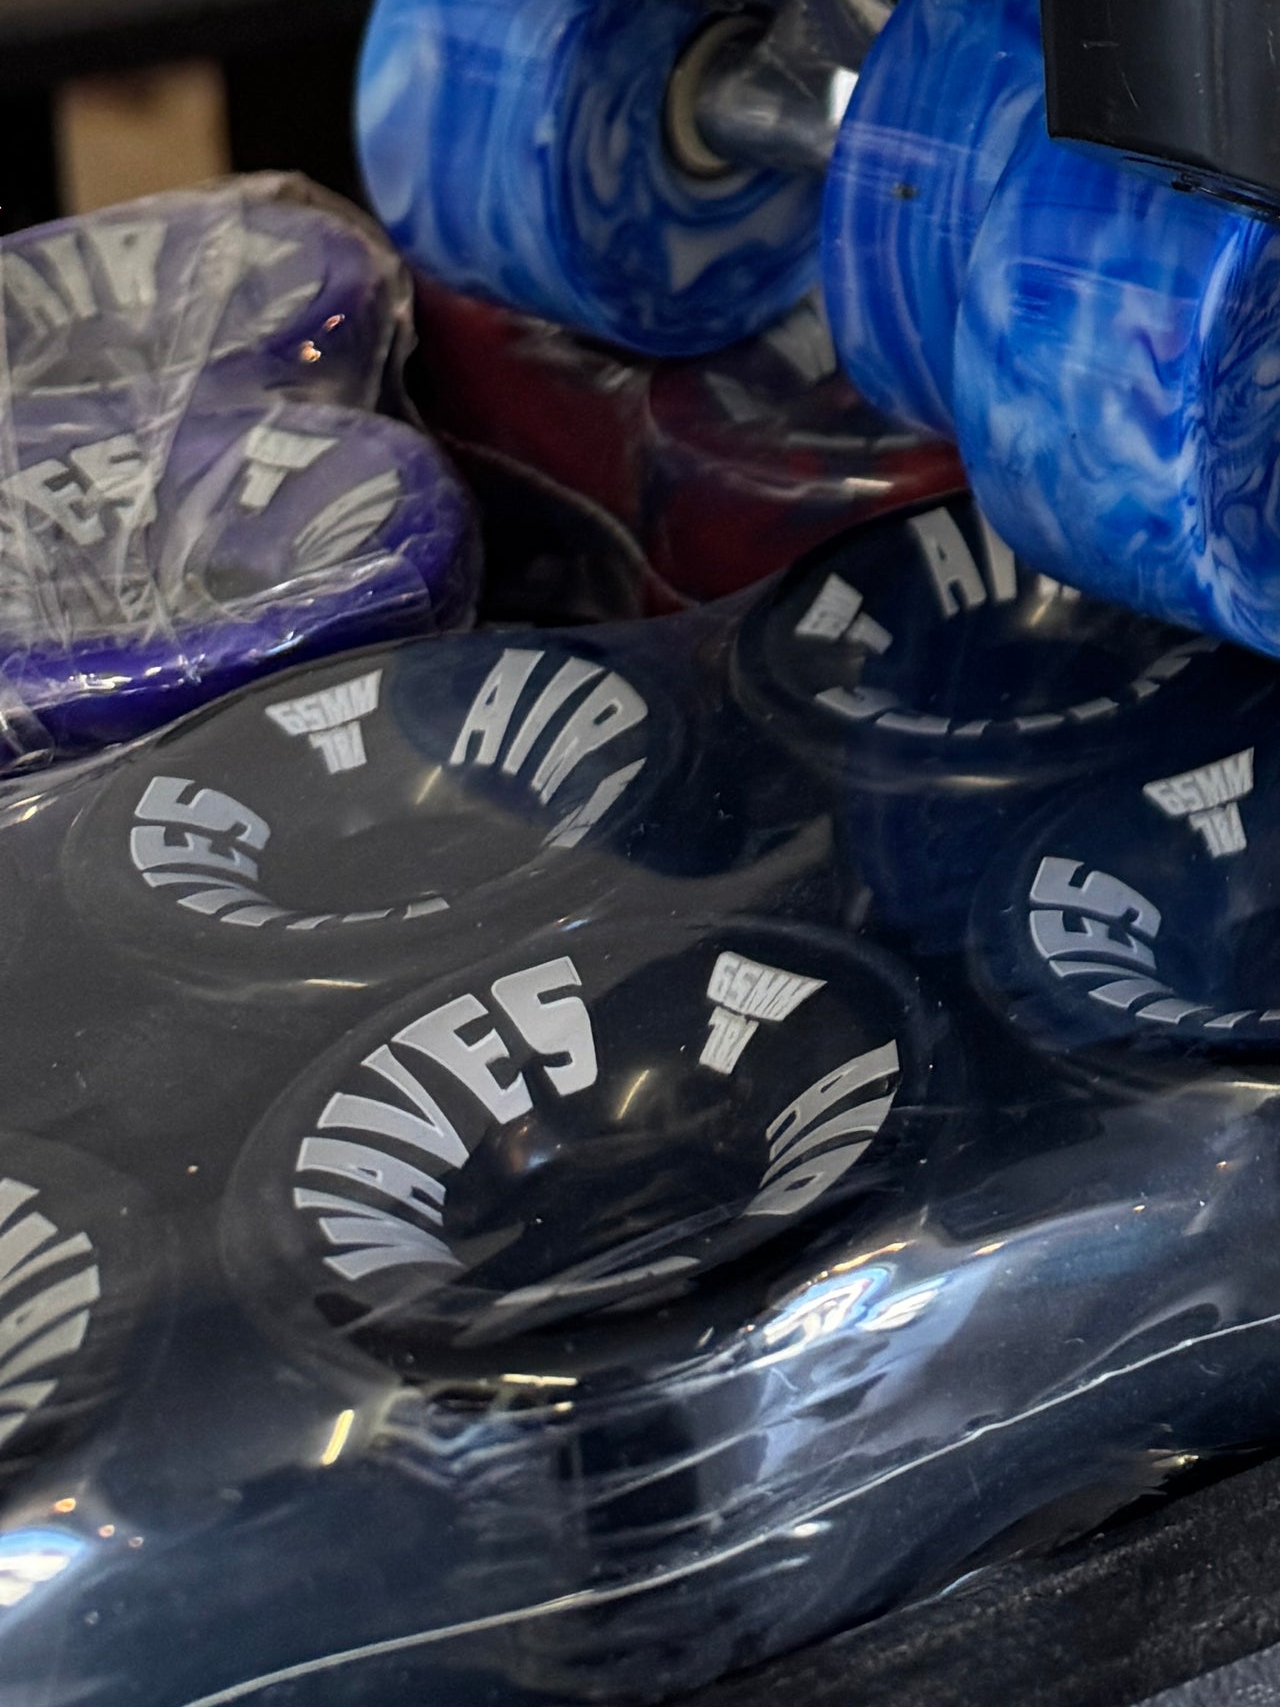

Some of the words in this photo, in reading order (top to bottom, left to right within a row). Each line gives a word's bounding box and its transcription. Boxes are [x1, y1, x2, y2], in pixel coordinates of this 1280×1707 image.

[449, 648, 649, 807] AIR
[1142, 745, 1255, 817] 65MM
[706, 950, 829, 1023] 65MM
[293, 955, 599, 1282] WAVES
